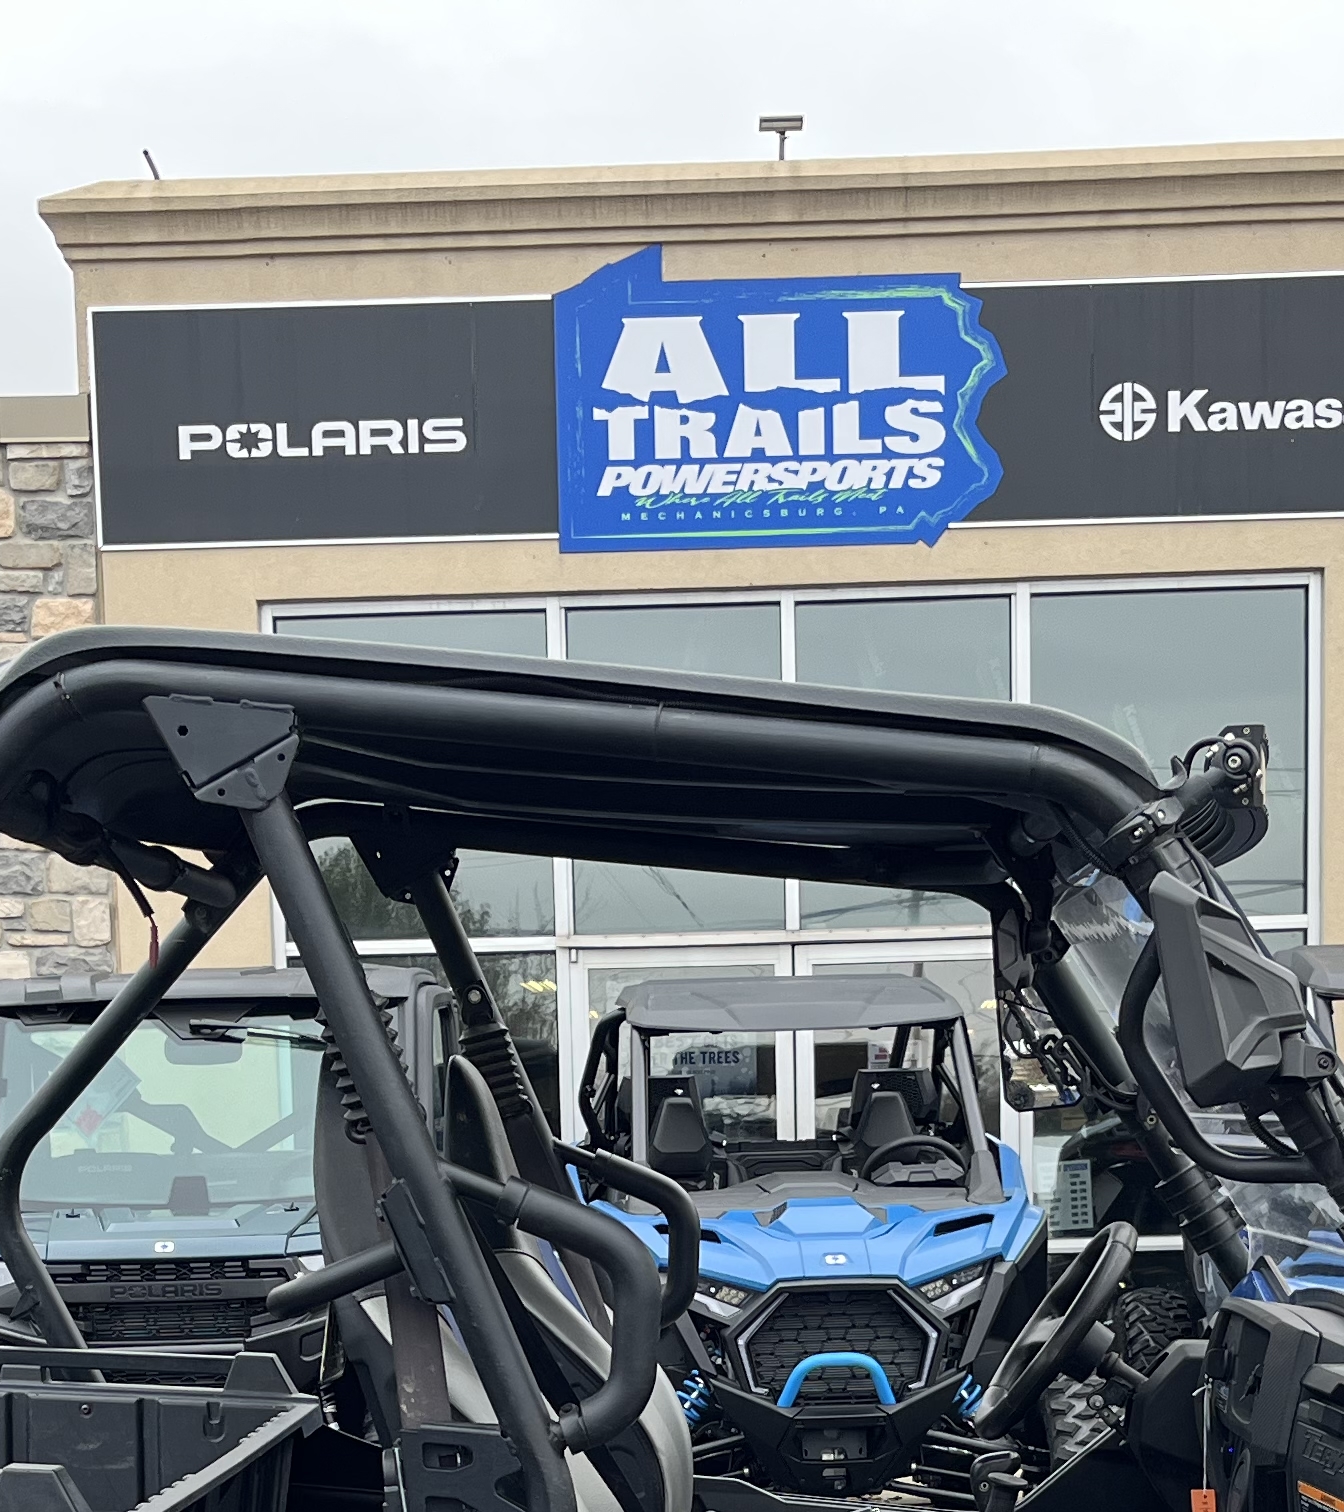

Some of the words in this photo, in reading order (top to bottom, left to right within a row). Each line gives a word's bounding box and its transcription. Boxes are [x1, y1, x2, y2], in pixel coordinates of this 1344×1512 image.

[601, 310, 945, 404] ALL
[177, 417, 467, 460] POLARIS
[593, 399, 947, 461] TRAILS
[597, 457, 945, 497] POWERSPORTS
[634, 492, 711, 509] Where
[713, 489, 763, 508] All
[764, 488, 827, 505] Trails
[878, 505, 904, 515] PA
[700, 1050, 740, 1065] TREES
[109, 1282, 223, 1299] POLARIS
